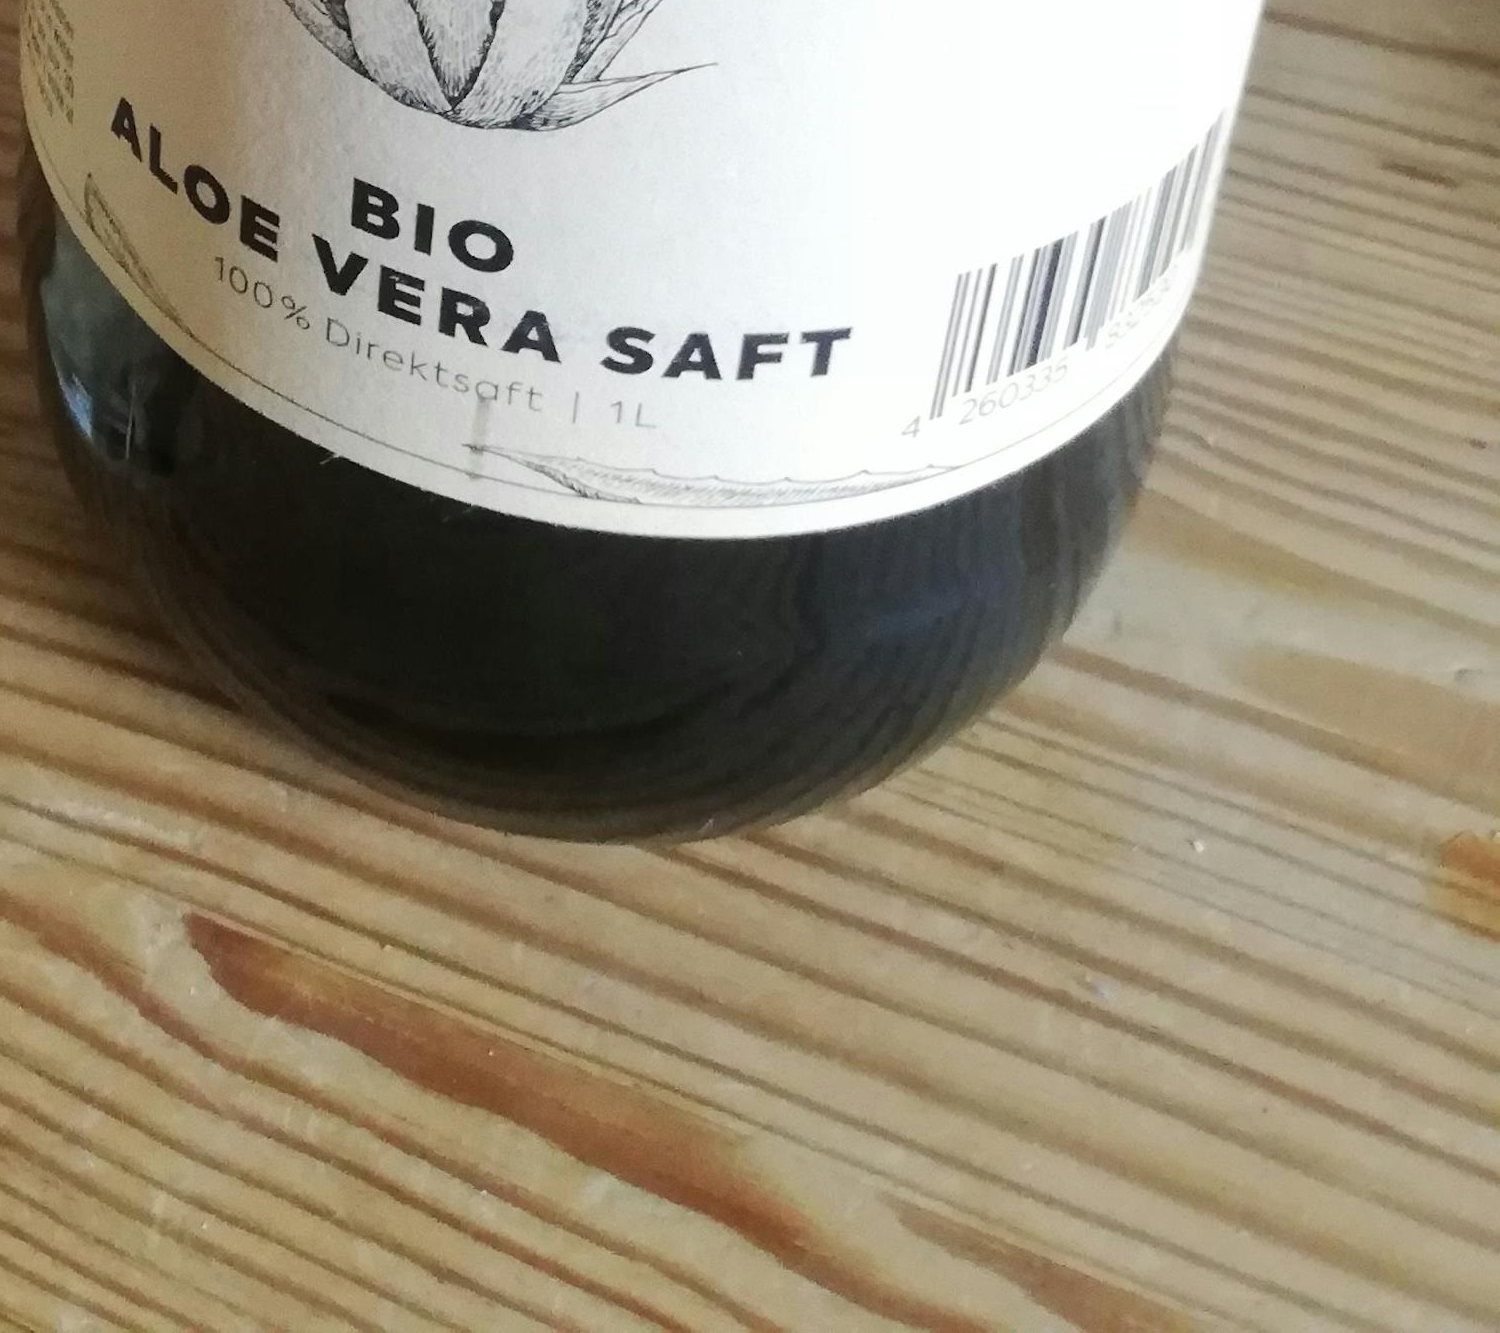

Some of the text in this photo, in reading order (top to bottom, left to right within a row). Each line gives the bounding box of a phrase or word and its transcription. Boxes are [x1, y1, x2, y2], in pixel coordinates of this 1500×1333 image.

[110, 97, 853, 381] ALOE VERA SAFT
[351, 176, 514, 274] BIO
[213, 255, 312, 332] 100%
[324, 316, 544, 413] Direktsaft
[609, 399, 658, 430] 1L
